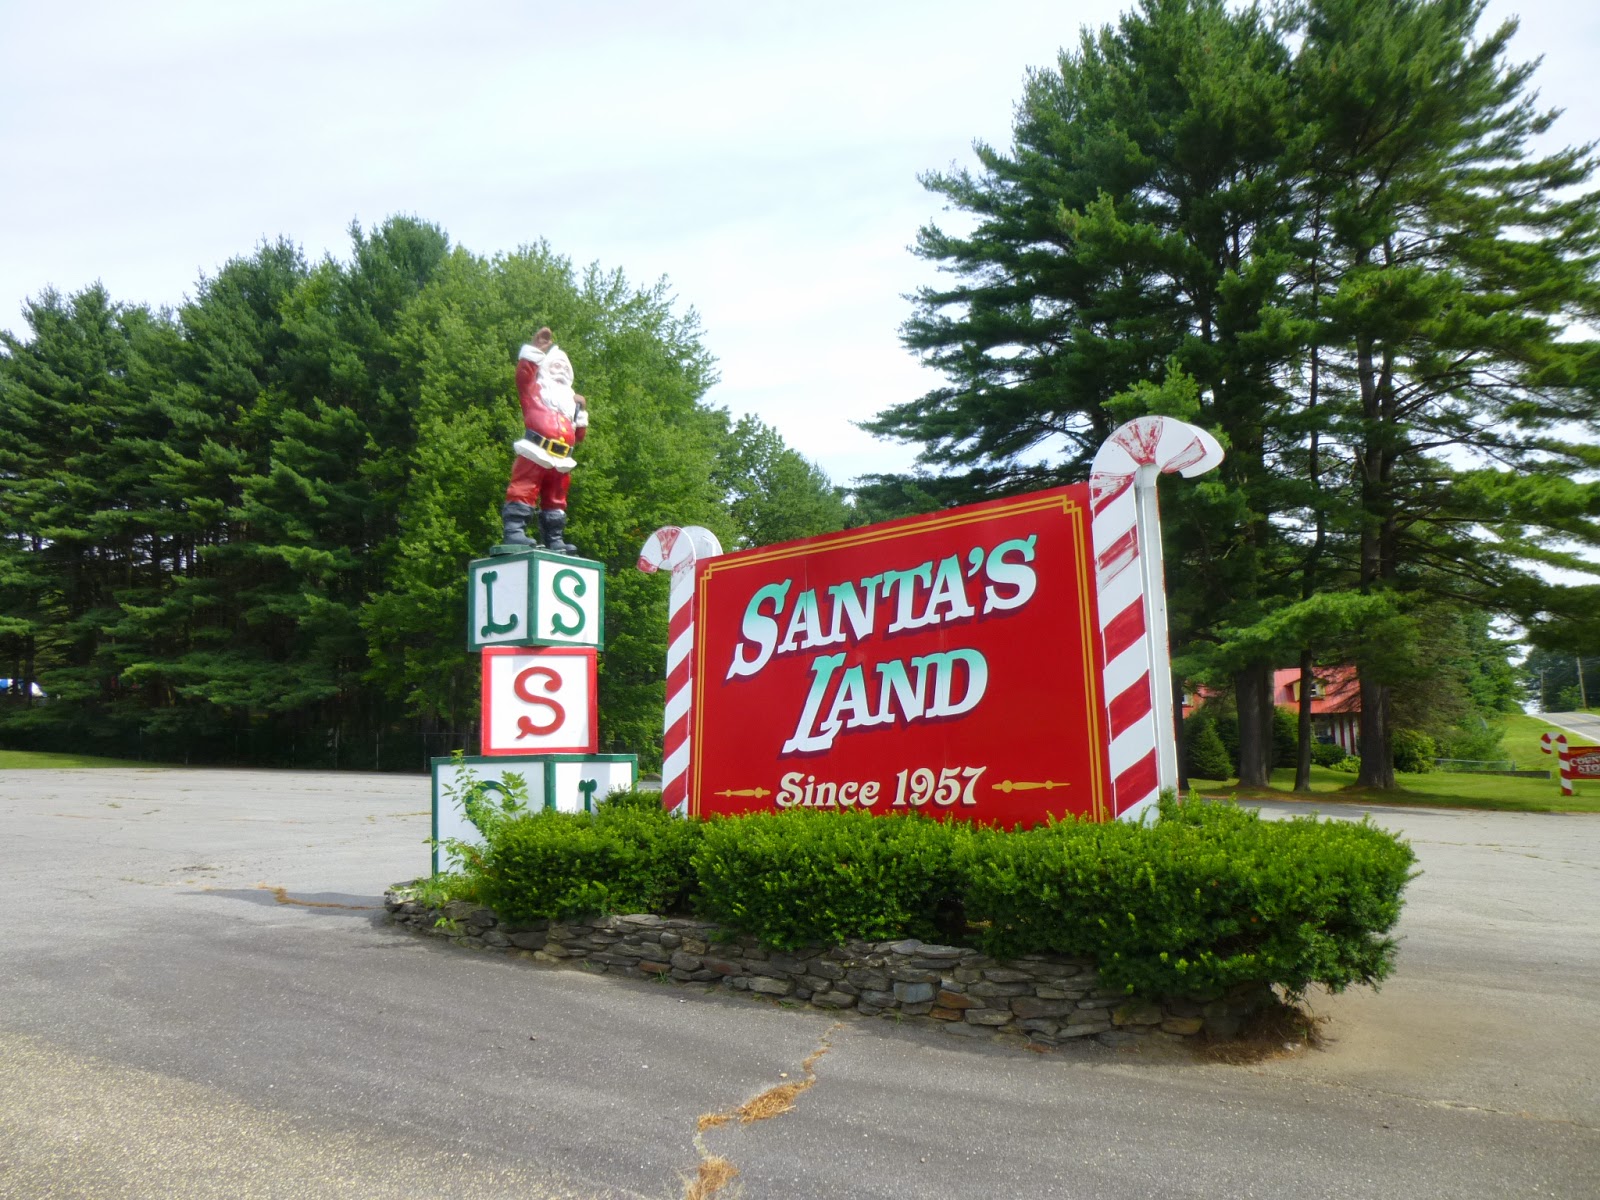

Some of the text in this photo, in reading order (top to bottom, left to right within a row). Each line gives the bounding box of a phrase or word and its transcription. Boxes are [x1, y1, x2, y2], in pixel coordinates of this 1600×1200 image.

[480, 570, 519, 638] L
[551, 568, 587, 636] S
[726, 534, 1038, 681] SANTA'S
[513, 665, 566, 740] S
[781, 648, 989, 754] LAND
[775, 765, 987, 808] Since 1957
